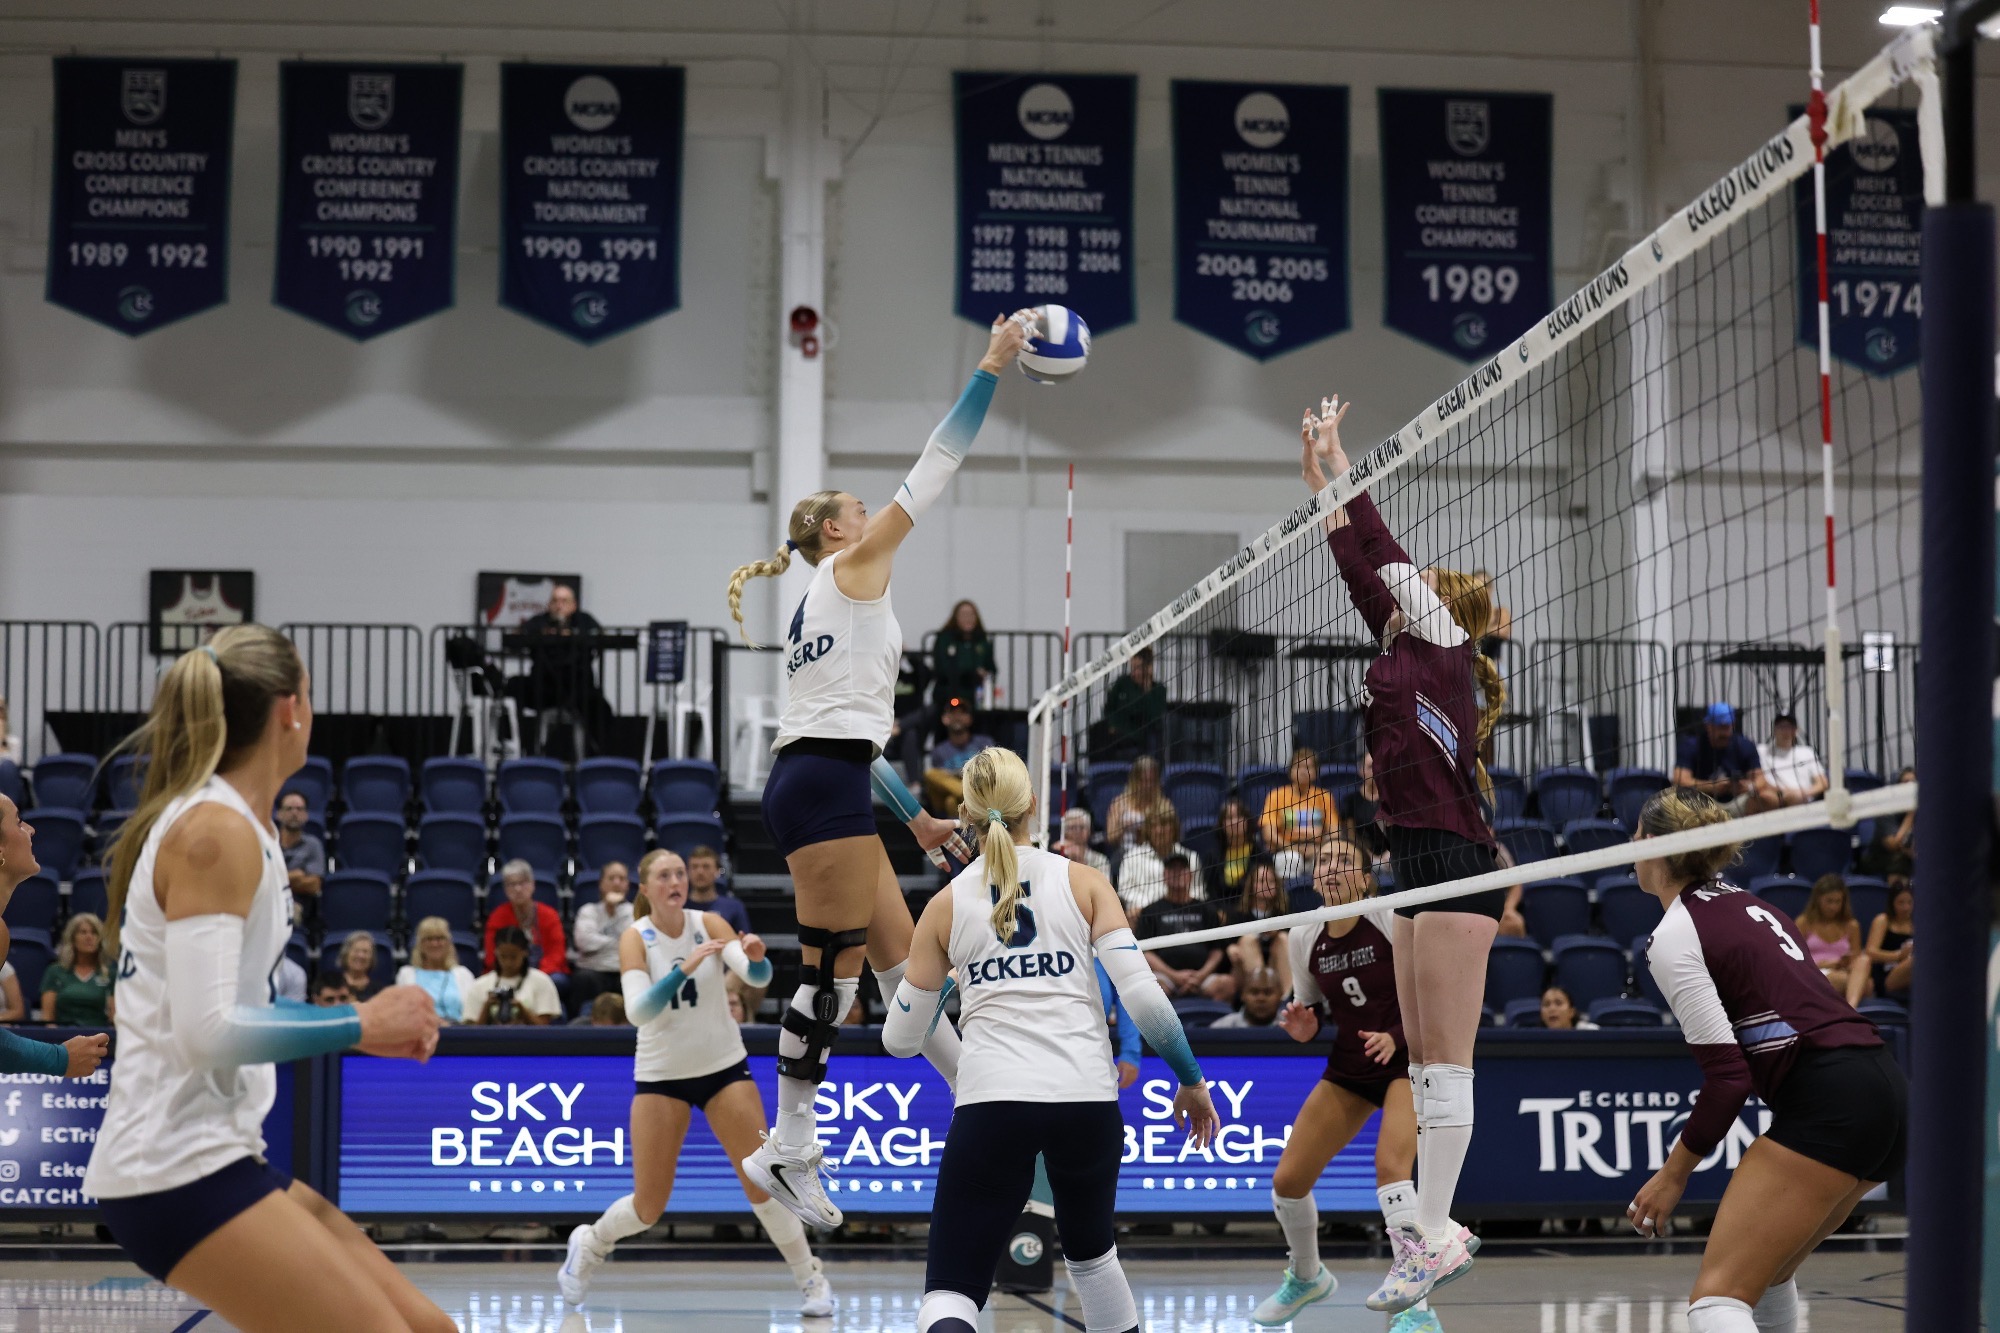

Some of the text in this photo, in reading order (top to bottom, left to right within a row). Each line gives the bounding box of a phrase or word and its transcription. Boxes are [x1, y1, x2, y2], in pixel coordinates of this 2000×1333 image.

[116, 130, 166, 147] MEN'S
[329, 134, 408, 153] WOMEN'S
[552, 136, 631, 154] WOMEN'S
[74, 152, 207, 171] CROSS COUNTRY
[989, 145, 1102, 164] MEN'S TENNIS
[1222, 154, 1299, 173] WOMEN'S
[302, 156, 436, 176] CROSS COUNTRY
[524, 157, 658, 177] CROSS COUNTRY
[1428, 161, 1504, 180] WOMEN'S
[86, 176, 193, 194] CONFERENCE
[1003, 168, 1086, 187] NATIONAL
[1235, 177, 1289, 195] TENNIS
[1687, 136, 1793, 232] ECKERD TRITONS
[1855, 178, 1895, 192] MEN'S
[315, 179, 421, 198] CONFERENCE
[548, 181, 629, 199] NATIONAL
[1441, 184, 1495, 202] TENNIS
[89, 199, 188, 217] CHAMPIONS
[988, 191, 1104, 211] TOURNAMENT
[1221, 199, 1299, 218] NATIONAL
[318, 202, 416, 221] CHAMPIONS
[534, 203, 646, 222] TOURNAMENT
[1416, 206, 1518, 226] CONFERENCE
[1207, 220, 1316, 241] TOURNAMENT
[1844, 215, 1910, 229] NATIONAL
[309, 236, 423, 258] 1990 1991
[973, 226, 1120, 248] 1997 1998 1999
[1422, 229, 1516, 248] CHAMPIONS
[1832, 231, 1921, 247] TOURNAMENT
[70, 243, 207, 267] 1989 1992
[523, 238, 657, 259] 1990 1991
[340, 261, 391, 281] 1992
[562, 262, 619, 282] 1992
[1197, 256, 1328, 280] 2004 2005
[1233, 281, 1292, 302] 2006
[1423, 266, 1519, 302] 1989
[1547, 259, 1629, 340] ECKERD TRITONS
[1834, 282, 1922, 318] 1974
[1437, 356, 1502, 421] ECKERD TRITONS
[1745, 905, 1804, 960] 3
[968, 951, 1074, 986] ECKERD
[1342, 976, 1367, 1007] 9
[471, 1081, 585, 1122] SKY
[815, 1081, 921, 1121] SKY
[1142, 1079, 1253, 1120] SY
[1578, 1089, 1680, 1108] ECKERD
[432, 1126, 624, 1166] BEACH
[770, 1126, 945, 1166] EACH
[469, 1180, 585, 1192] RESORT
[829, 1179, 923, 1192] ESORT
[1142, 1177, 1257, 1190] RESORT
